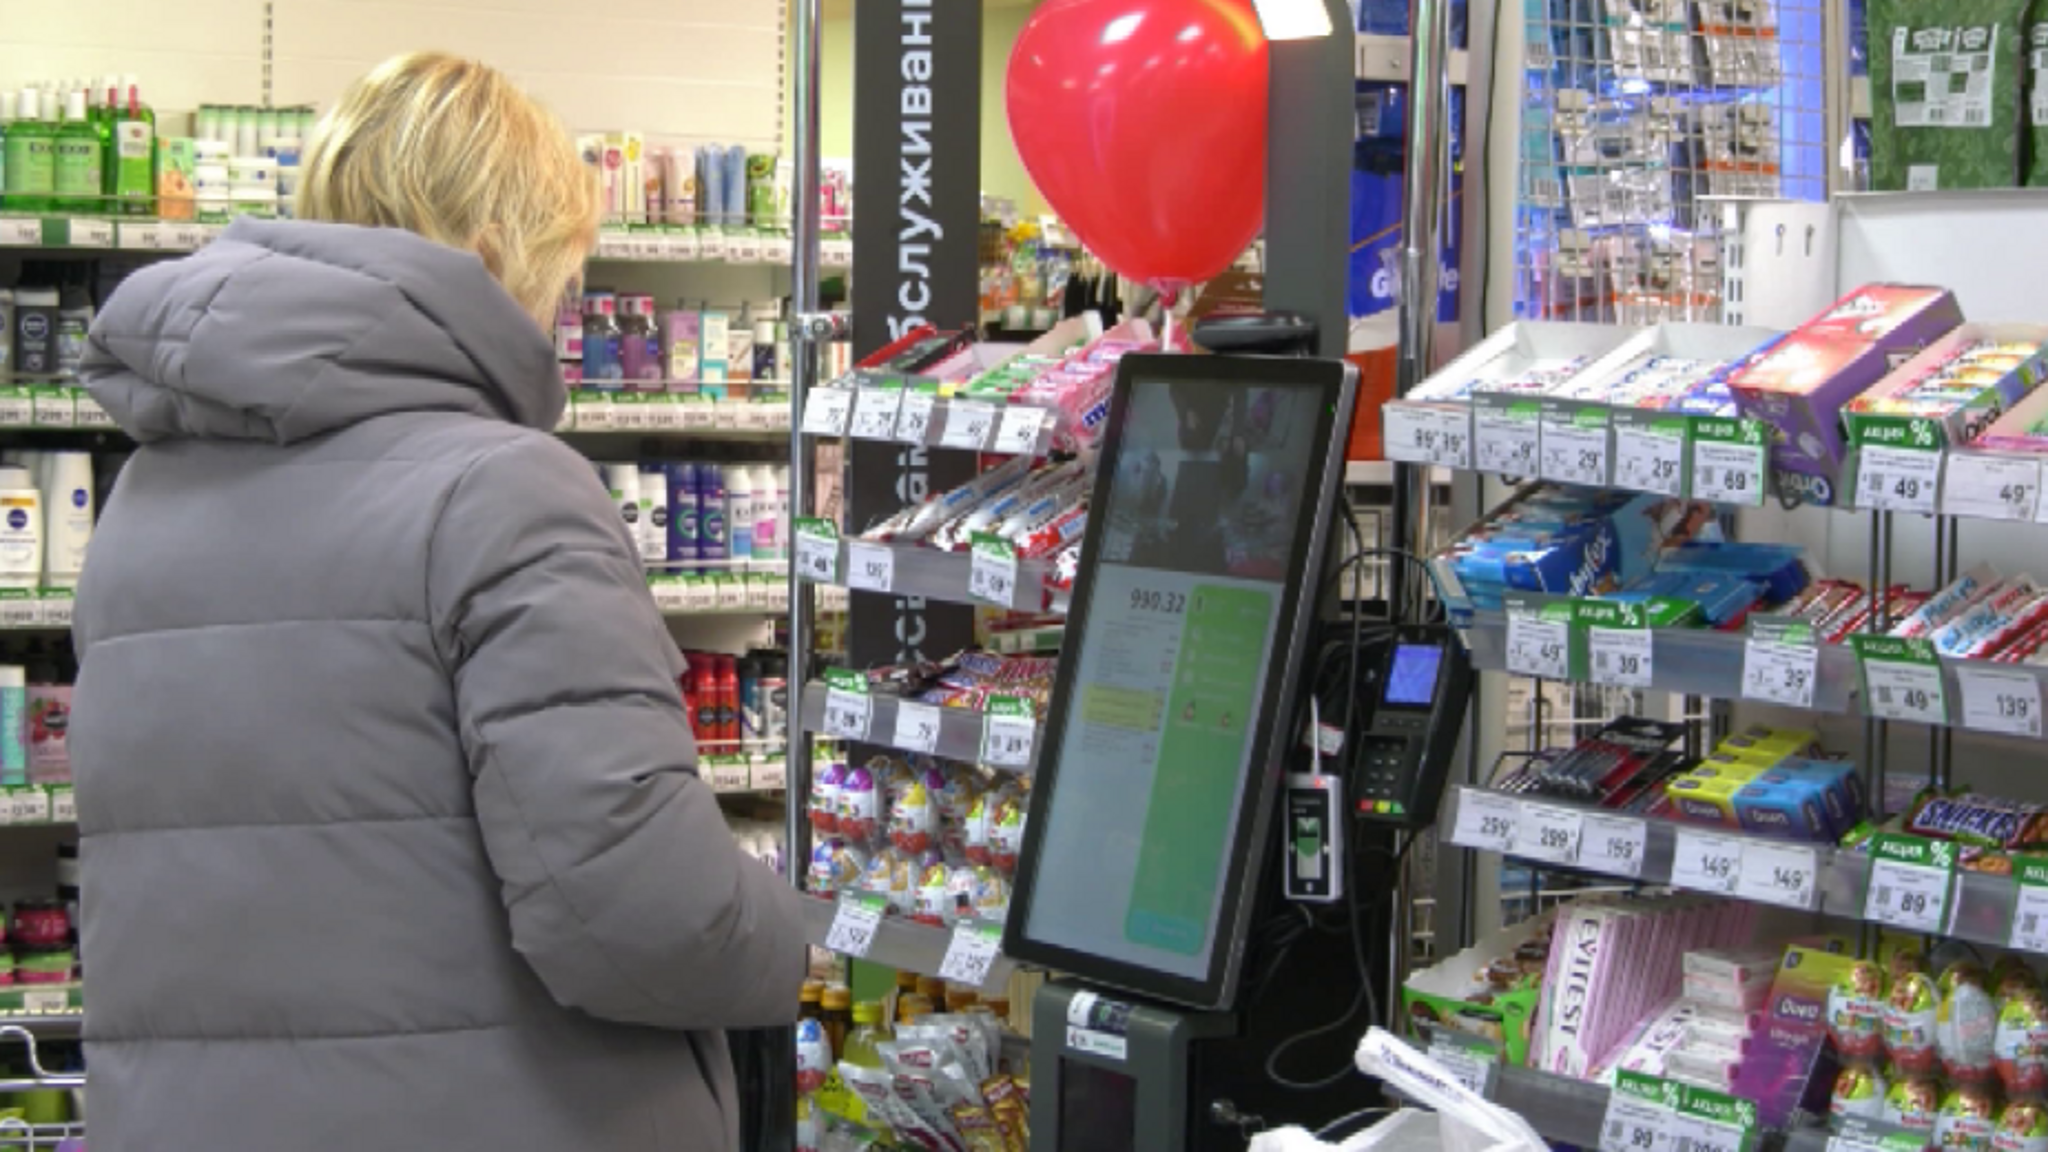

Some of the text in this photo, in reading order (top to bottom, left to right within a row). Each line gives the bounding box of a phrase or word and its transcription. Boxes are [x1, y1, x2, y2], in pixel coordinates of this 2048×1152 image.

[1895, 477, 1919, 498] 49
[2000, 484, 2024, 504] 49
[1904, 690, 1928, 711] 49
[1996, 694, 2028, 718] 139
[1901, 892, 1926, 915] 89
[1559, 918, 1600, 1037] EVITEST
